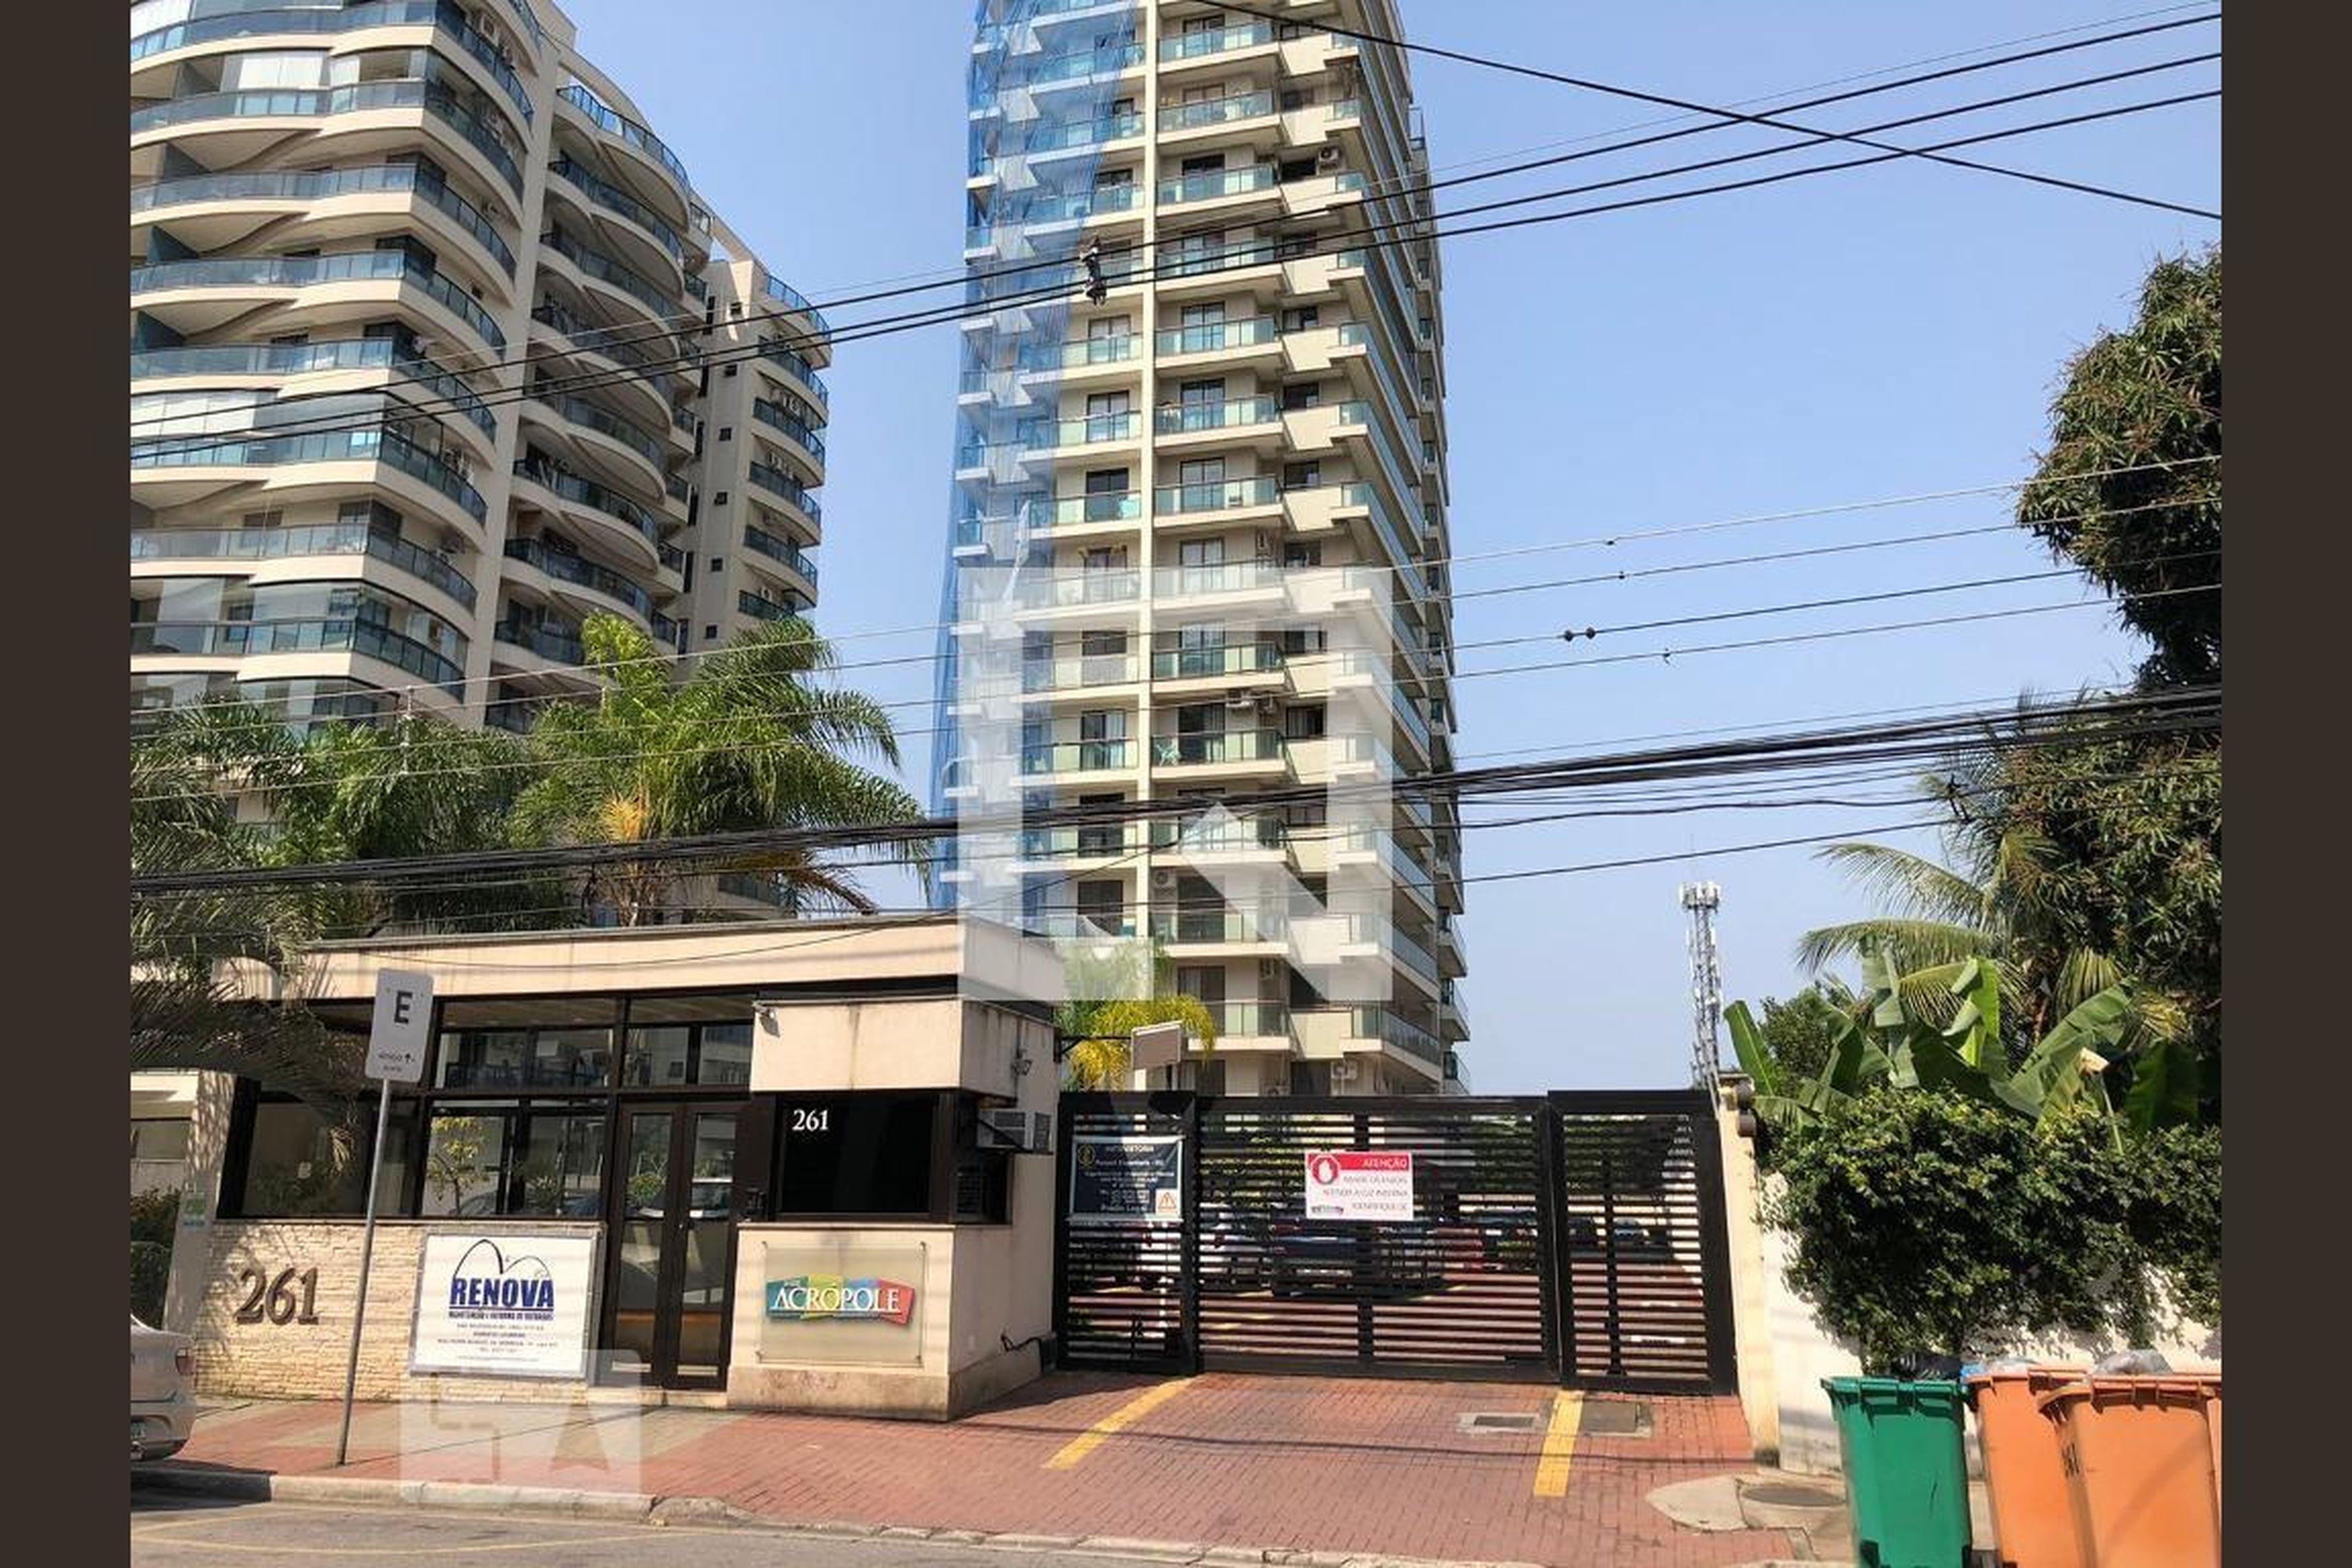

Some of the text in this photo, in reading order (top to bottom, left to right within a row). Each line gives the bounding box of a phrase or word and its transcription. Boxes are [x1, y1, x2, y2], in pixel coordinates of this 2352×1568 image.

[394, 990, 413, 1024] E
[792, 1109, 828, 1131] 261
[236, 1263, 318, 1326] 261
[449, 1277, 554, 1308] RENOVA
[769, 1282, 902, 1313] ACRÓPOLE
